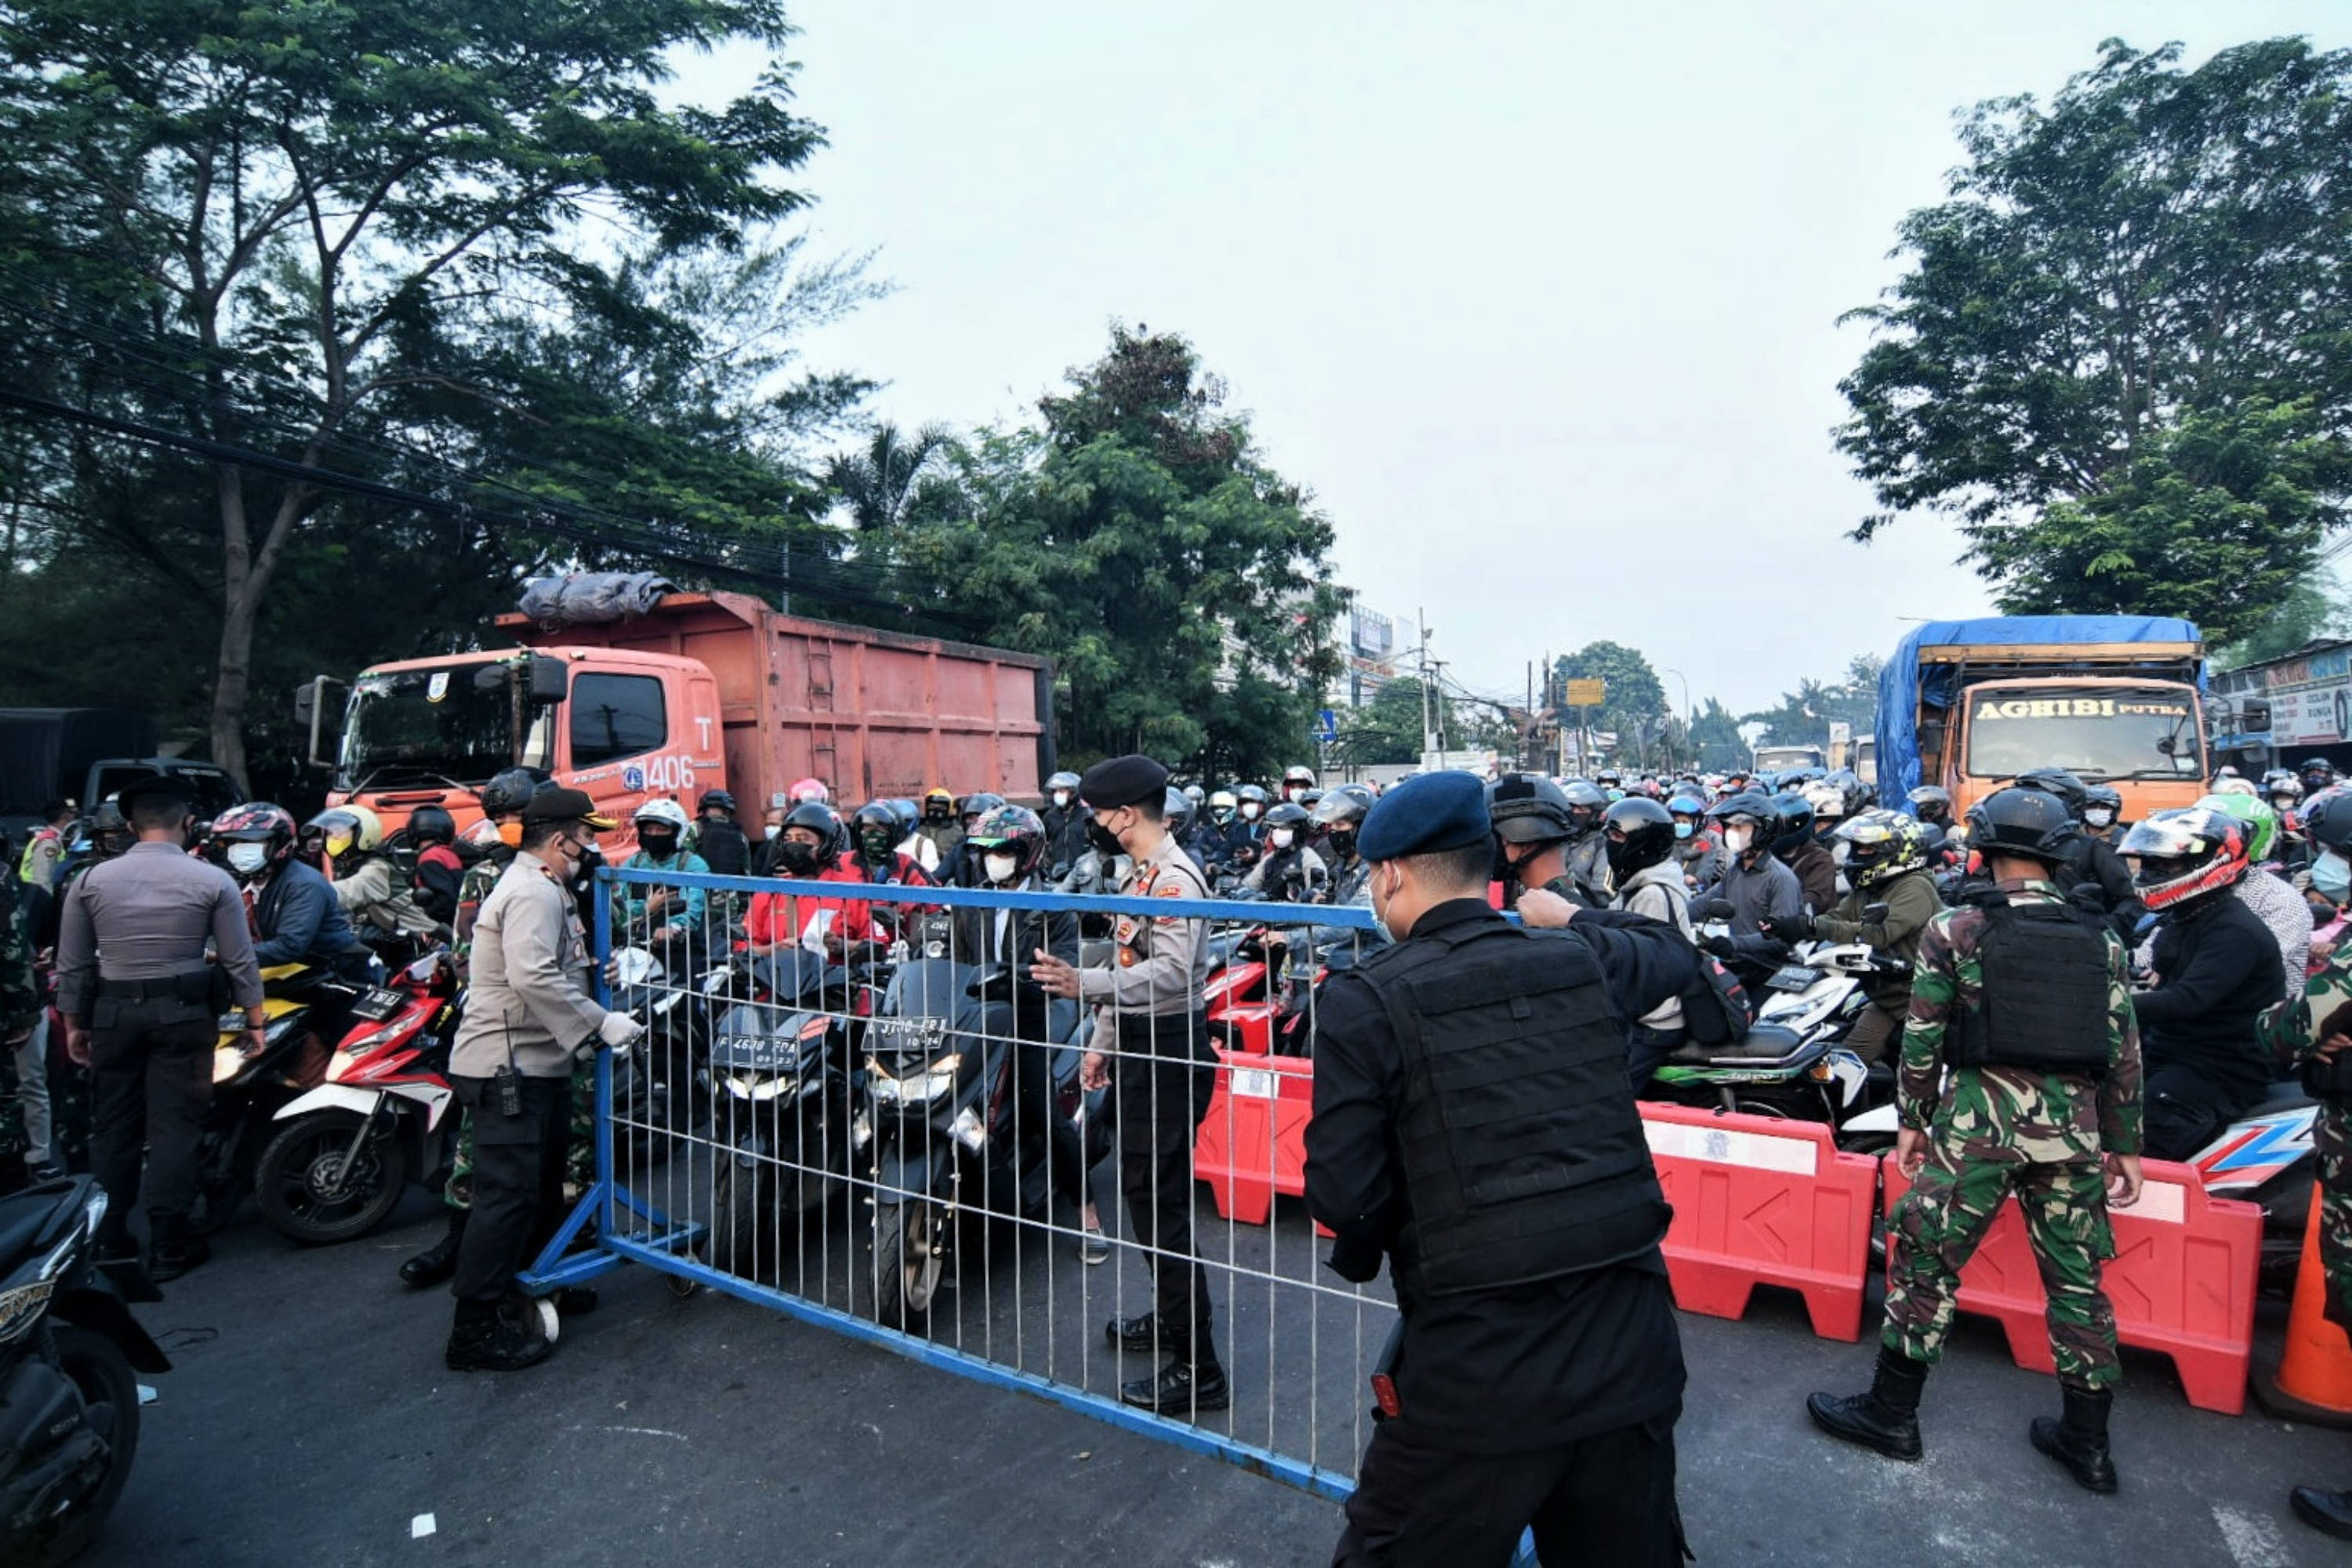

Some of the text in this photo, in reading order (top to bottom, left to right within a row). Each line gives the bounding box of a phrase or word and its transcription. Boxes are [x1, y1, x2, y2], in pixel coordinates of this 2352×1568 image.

[1976, 699, 2187, 720] AGHIBI PUTRA
[695, 717, 712, 751] T
